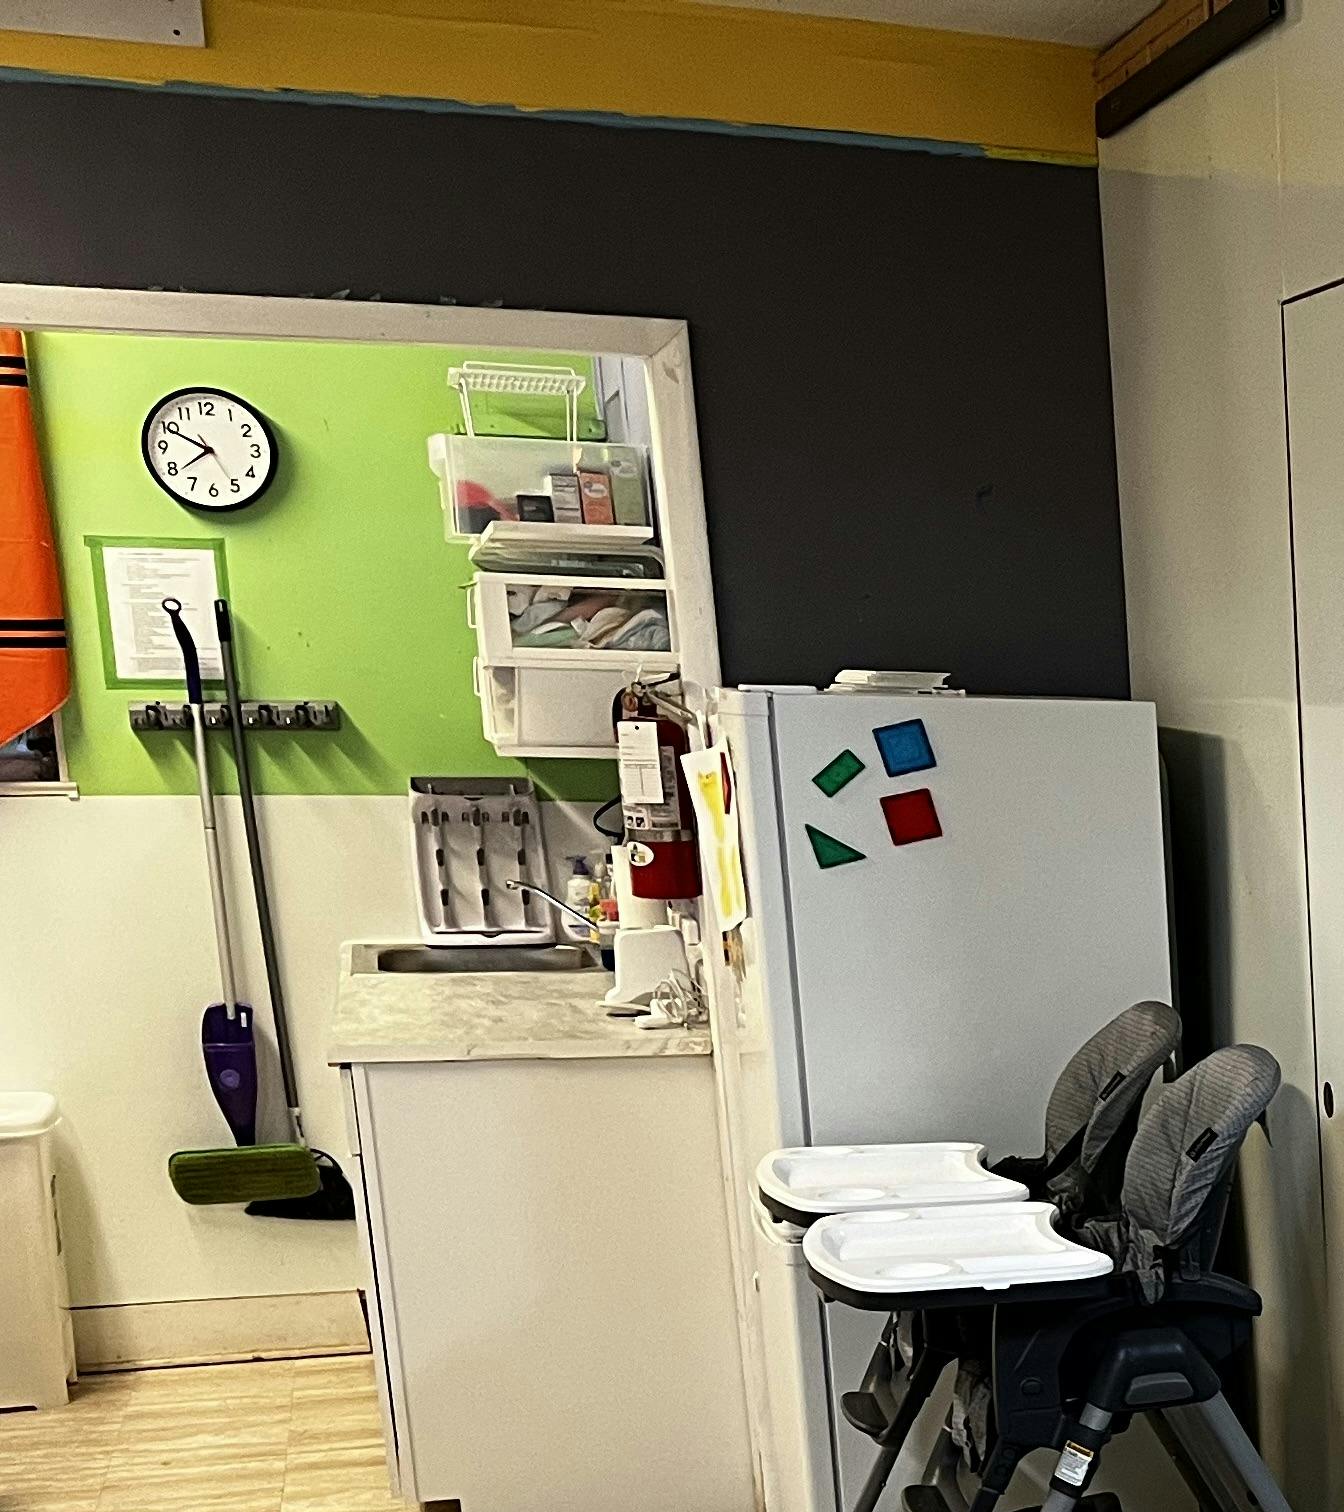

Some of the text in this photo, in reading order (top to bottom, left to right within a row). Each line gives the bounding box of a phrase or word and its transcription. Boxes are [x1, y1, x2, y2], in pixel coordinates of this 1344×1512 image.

[178, 406, 191, 421] 11
[197, 401, 216, 416] 12
[227, 408, 233, 422] 1
[161, 420, 180, 434] 10
[240, 423, 252, 438] 2
[157, 439, 169, 454] 9
[249, 443, 261, 459] 3
[167, 461, 179, 476] 8
[245, 465, 256, 478] 4
[186, 476, 198, 491] 7
[208, 482, 219, 497] 6
[230, 478, 241, 493] 5
